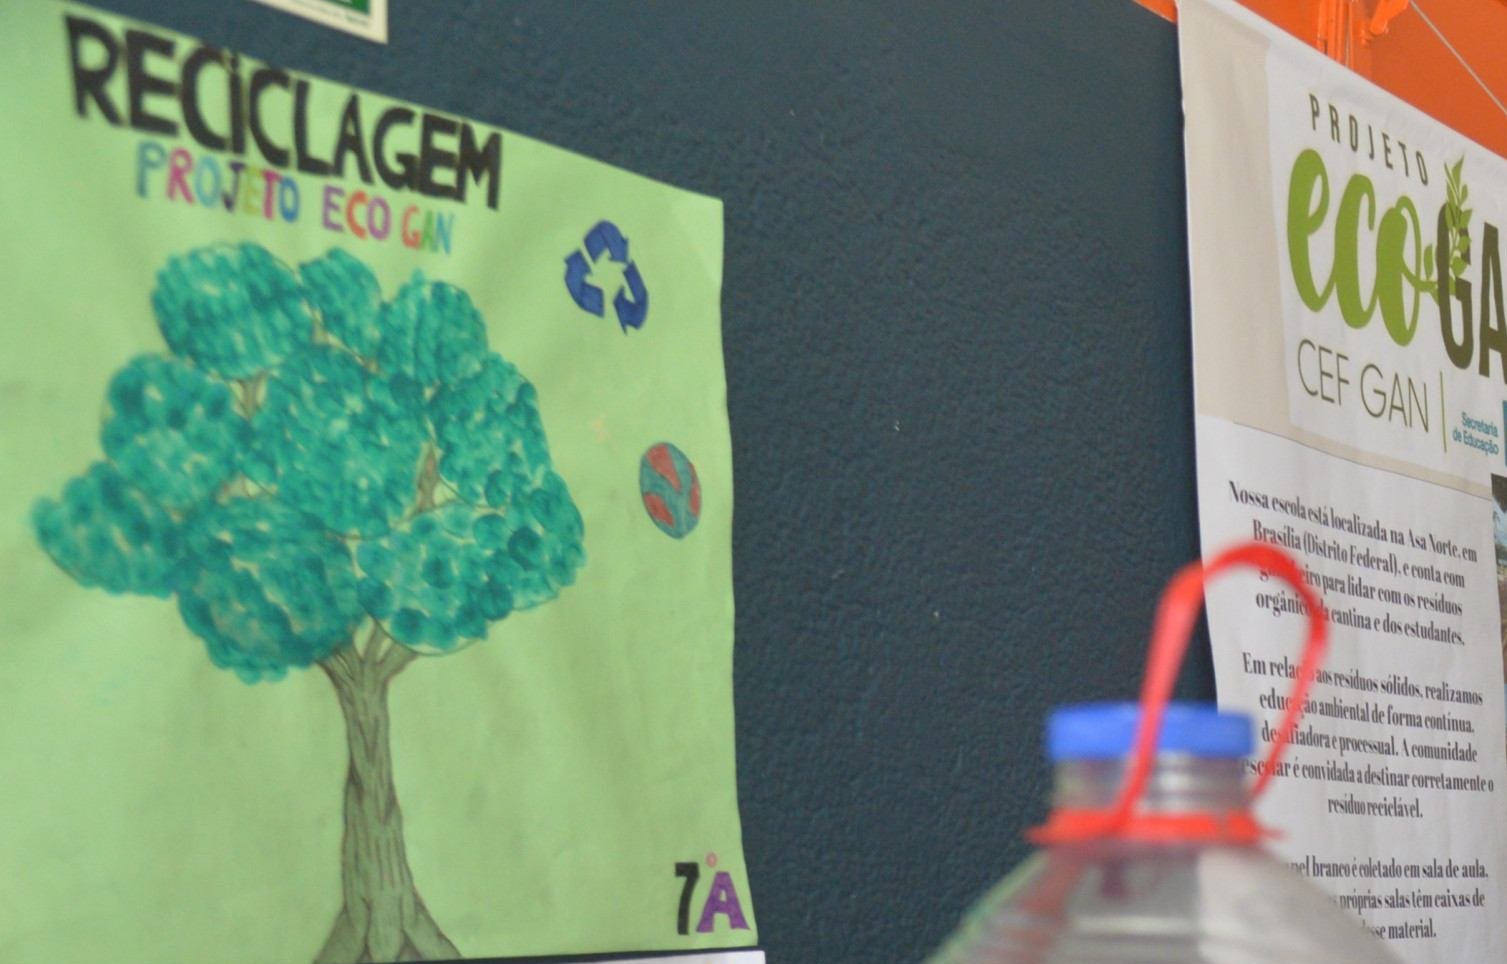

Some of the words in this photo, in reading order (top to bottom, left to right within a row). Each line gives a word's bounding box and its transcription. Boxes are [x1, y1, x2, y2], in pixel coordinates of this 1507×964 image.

[1309, 93, 1428, 186] PROJETO
[136, 141, 299, 222] PROJETO
[322, 185, 391, 240] ECO
[402, 205, 455, 254] GAN
[1298, 339, 1349, 406] CEF
[1360, 364, 1429, 432] GAN
[1452, 425, 1462, 442] de
[1462, 411, 1498, 438] Secretaria
[1229, 480, 1269, 508] Nossa
[1272, 496, 1306, 520] escola
[1308, 505, 1329, 527] está
[1330, 507, 1388, 542] localizada
[1390, 528, 1405, 545] na
[1409, 528, 1427, 551] Asa
[1462, 547, 1478, 563] em
[1252, 519, 1301, 550] Brasília
[1303, 531, 1348, 563] (Distrito
[1403, 563, 1409, 577] e
[1411, 564, 1442, 583] conta
[1444, 573, 1465, 588] com
[1322, 573, 1345, 595] para
[1347, 574, 1376, 600] lidar
[1378, 588, 1401, 605] com
[1403, 592, 1416, 607] os
[1417, 592, 1463, 616] resíduos
[1331, 607, 1371, 630] cantina
[1374, 617, 1381, 632] e
[1383, 612, 1402, 634] dos
[1242, 652, 1266, 676] Em
[1316, 668, 1333, 683] aos
[1334, 668, 1378, 693] resíduos
[1425, 681, 1484, 705] realizamos
[1319, 696, 1370, 723] ambiental
[1371, 703, 1385, 724] de
[1387, 704, 1423, 728] forma
[1332, 735, 1338, 750] e
[1338, 735, 1399, 757] processual.
[1402, 738, 1410, 757] A
[1411, 741, 1478, 763] comunidade
[1293, 756, 1300, 778] é
[1302, 760, 1355, 783] convidada
[1357, 770, 1363, 784] a
[1364, 763, 1410, 787] destinar
[1412, 773, 1486, 792] corretamente
[1488, 779, 1494, 792] o
[1328, 793, 1366, 815] resíduo
[1367, 796, 1424, 818] reciclável.
[1312, 855, 1350, 877] branco
[1351, 856, 1358, 878] é
[1359, 857, 1402, 878] coletado
[1403, 864, 1420, 878] em
[1422, 858, 1444, 878] sala
[1445, 858, 1459, 878] de
[1461, 858, 1488, 879] aula.
[1339, 888, 1382, 916] próprias
[1384, 888, 1410, 908] salas
[1412, 888, 1433, 908] têm
[1434, 888, 1471, 908] caixas
[1472, 887, 1485, 907] de
[1388, 917, 1436, 939] material.
